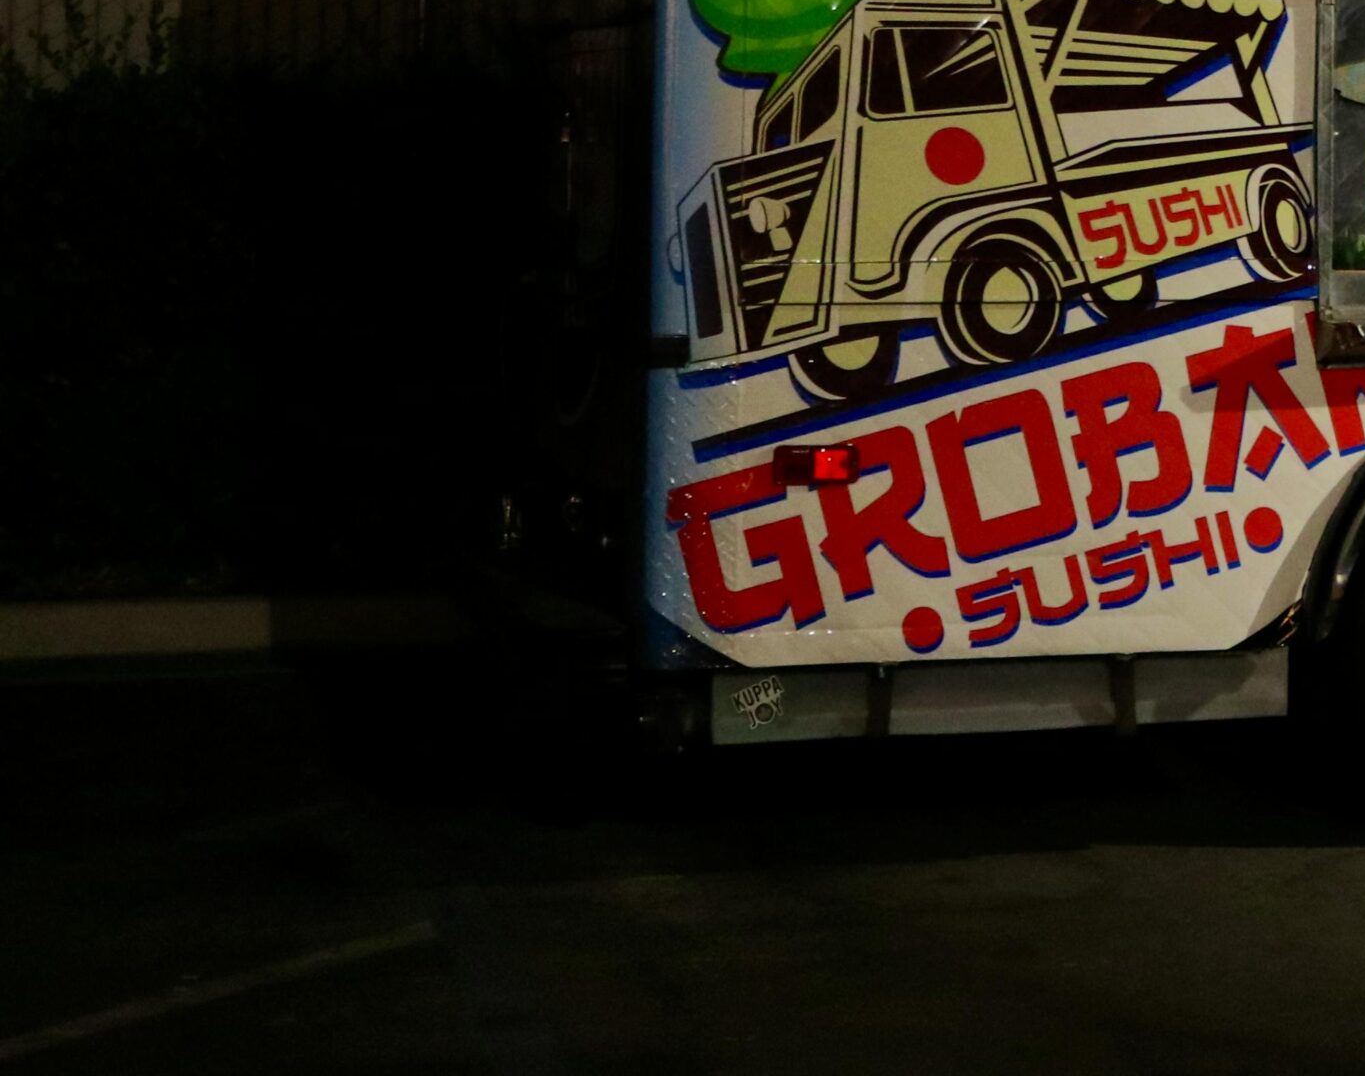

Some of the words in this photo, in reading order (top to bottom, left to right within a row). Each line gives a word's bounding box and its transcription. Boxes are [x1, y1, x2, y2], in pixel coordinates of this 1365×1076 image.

[1077, 183, 1244, 270] SUSHI
[954, 510, 1240, 649] SUSHI
[731, 675, 785, 713] KUPPA
[748, 697, 784, 729] JOY
